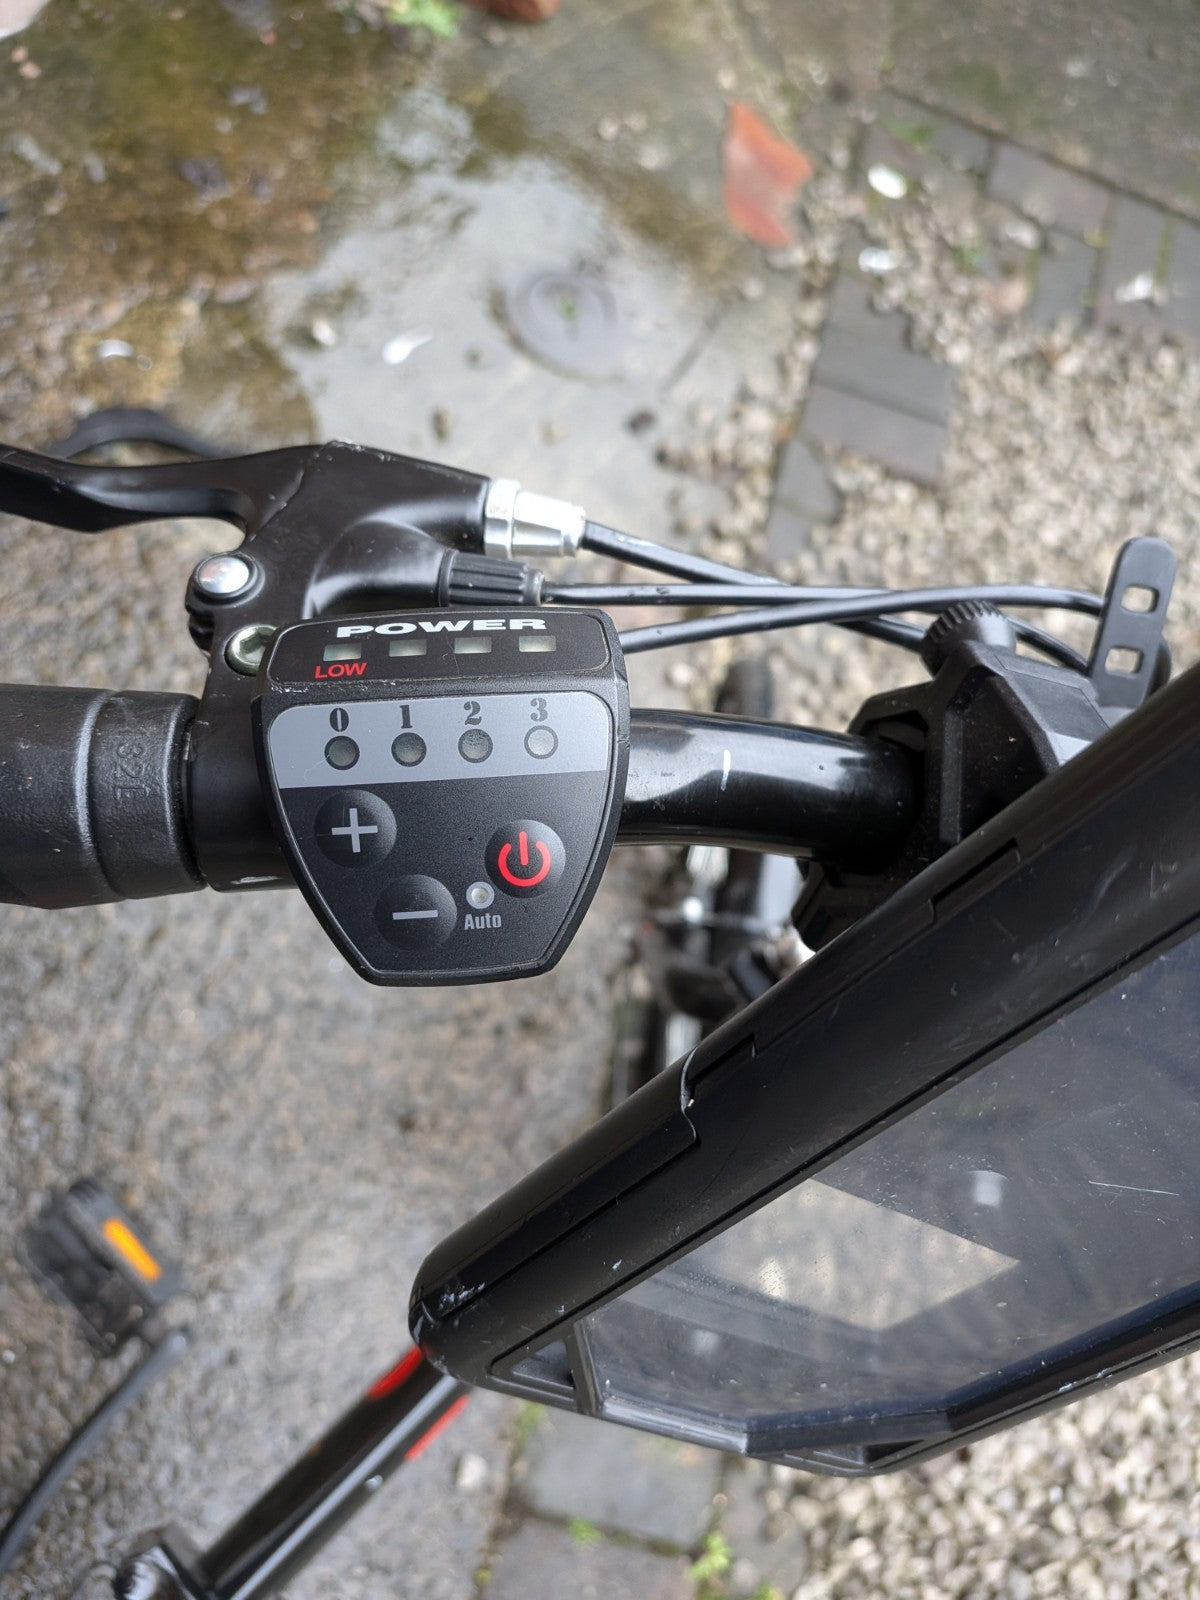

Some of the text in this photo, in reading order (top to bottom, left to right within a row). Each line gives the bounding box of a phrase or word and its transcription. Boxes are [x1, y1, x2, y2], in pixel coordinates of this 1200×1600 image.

[336, 618, 547, 638] POWER
[314, 662, 368, 679] LOW
[329, 698, 548, 732] 0 1 2 3
[463, 913, 502, 930] Auto
